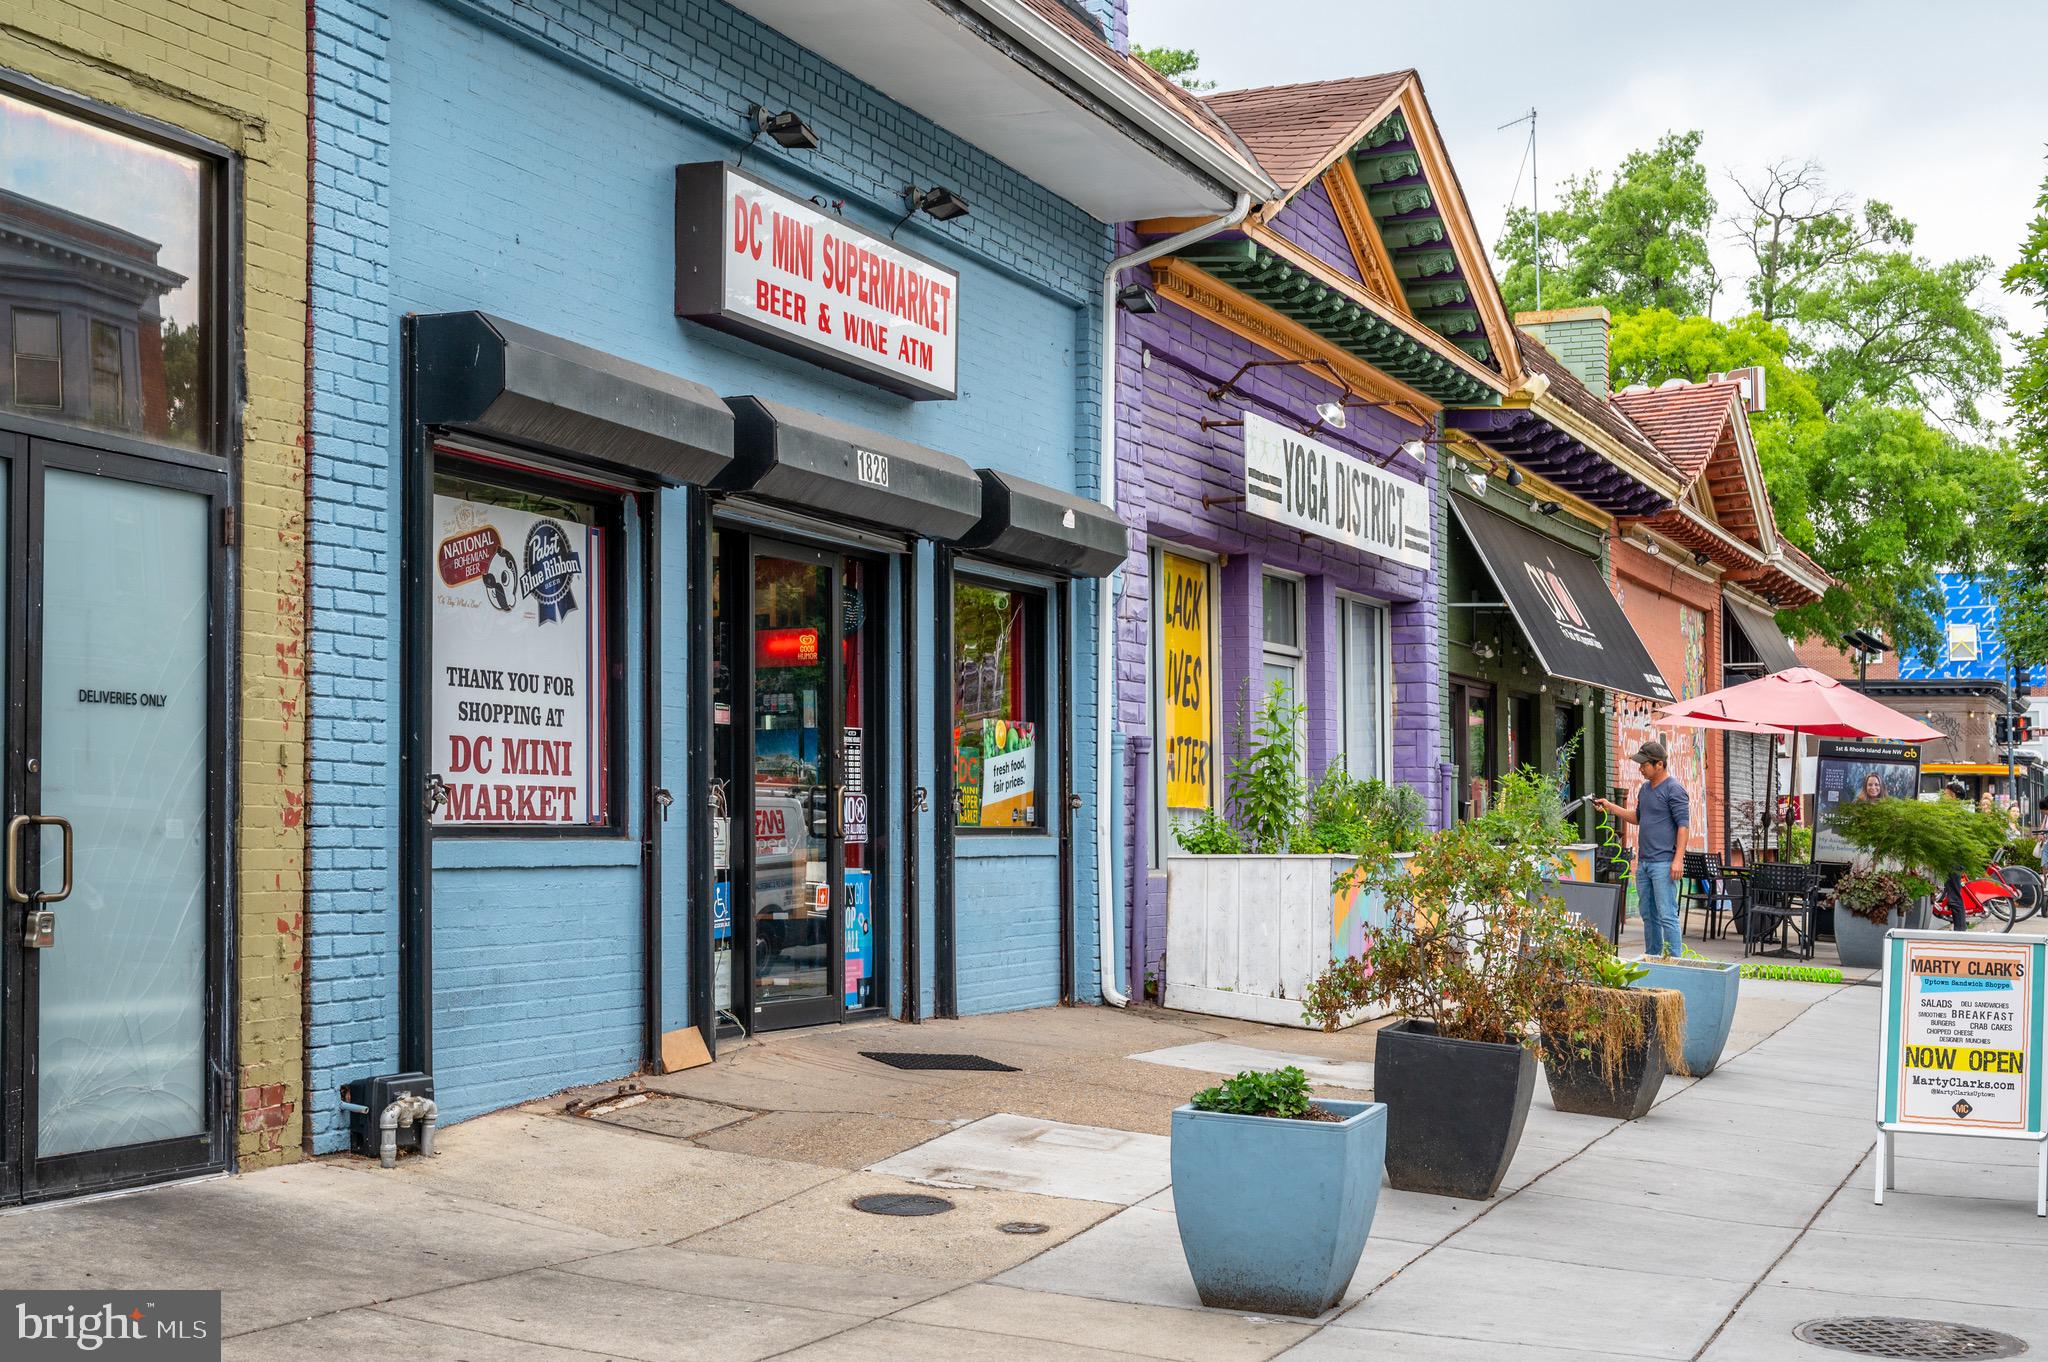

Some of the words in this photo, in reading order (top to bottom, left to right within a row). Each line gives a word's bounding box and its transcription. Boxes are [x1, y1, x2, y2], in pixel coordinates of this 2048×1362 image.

[735, 194, 763, 261] DC
[772, 211, 813, 282] MINI
[822, 233, 951, 336] SUPERMARKET
[756, 278, 807, 325] BEER
[818, 303, 832, 335] &
[843, 311, 888, 355] WINE
[898, 334, 933, 372] ATM
[859, 452, 887, 486] 1828
[1282, 438, 1330, 526] YOGA
[1335, 460, 1405, 550] DISTRICT
[443, 531, 495, 560] NATIONAL
[529, 532, 561, 565] Pabst
[465, 563, 481, 577] BEER
[521, 569, 545, 597] Blue
[543, 557, 581, 580] Ribbon
[1164, 571, 1203, 631] LACK
[446, 666, 504, 690] THANK
[507, 672, 540, 694] YOU
[543, 675, 575, 697] FOR
[1167, 648, 1202, 711] IVES
[78, 688, 138, 706] DELIVERIES
[140, 692, 168, 707] ONLY
[458, 701, 542, 726] SHOPPING
[545, 708, 565, 728] AT
[449, 735, 493, 774] DC
[502, 738, 572, 776] MINI
[993, 762, 1010, 778] fresh
[1011, 757, 1027, 771] food,
[1166, 735, 1210, 786] ATTER
[958, 757, 977, 785] DC
[993, 779, 1005, 794] fair
[1005, 775, 1026, 793] prices.
[444, 783, 577, 822] MARKET
[845, 906, 856, 929] OP
[1911, 958, 1960, 974] MARTY
[1968, 961, 2024, 978] CLARK'S
[1924, 978, 1949, 986] Uptown
[1951, 979, 1983, 987] Sandwich
[1985, 981, 2010, 989] Shoppe
[1921, 998, 1952, 1008] SALADS
[1974, 1001, 2009, 1009] SANDWICHES
[1951, 1010, 2014, 1021] BREAKFAST
[1969, 1022, 1988, 1030] CRAB
[1991, 1023, 2013, 1031] CAKES
[1965, 1037, 1991, 1045] MUNCHIES
[1906, 1046, 1957, 1070] NOW
[1969, 1050, 2024, 1073] OPEN
[1912, 1075, 2015, 1090] MartyClarks.com
[1931, 1088, 1996, 1098] @MartyClarksUptown
[1955, 1104, 1969, 1114] MC
